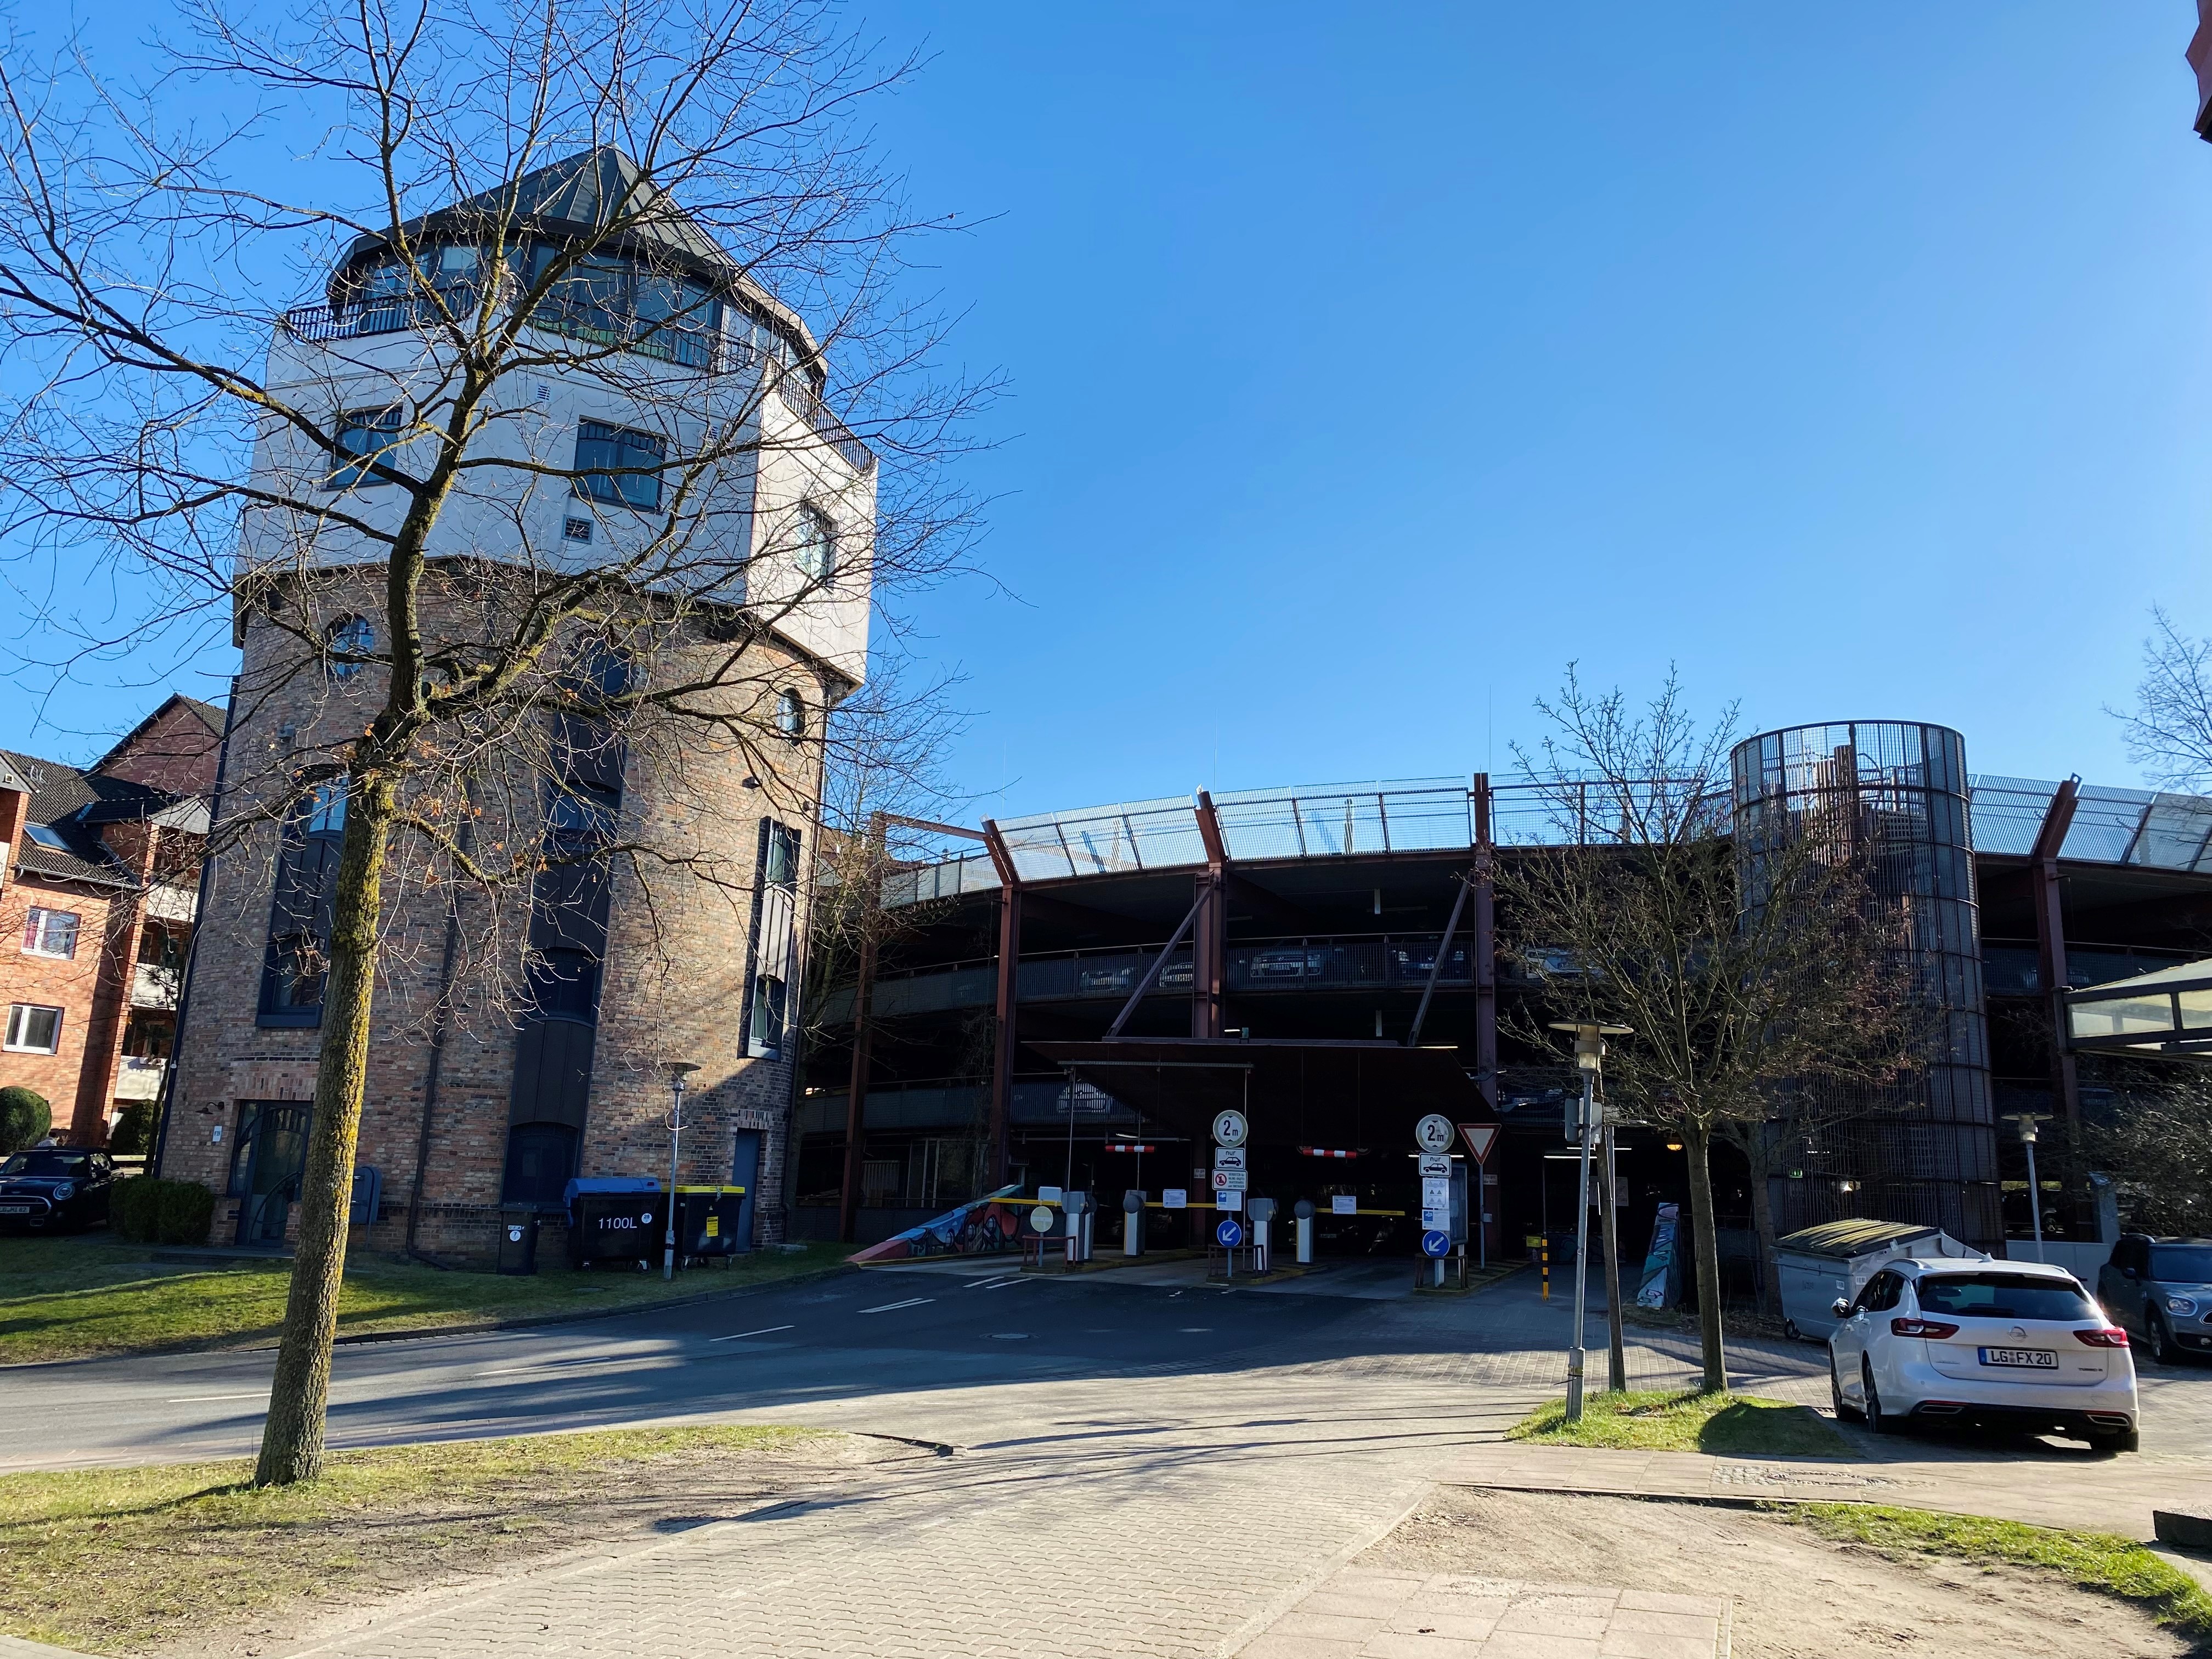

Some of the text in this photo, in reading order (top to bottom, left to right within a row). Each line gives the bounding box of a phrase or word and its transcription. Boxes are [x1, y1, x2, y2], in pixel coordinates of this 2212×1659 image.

[1223, 1120, 1231, 1136] 2
[1427, 1125, 1435, 1141] 2
[599, 1217, 637, 1229] 1100L
[1991, 1350, 2052, 1365] LG FX 20
